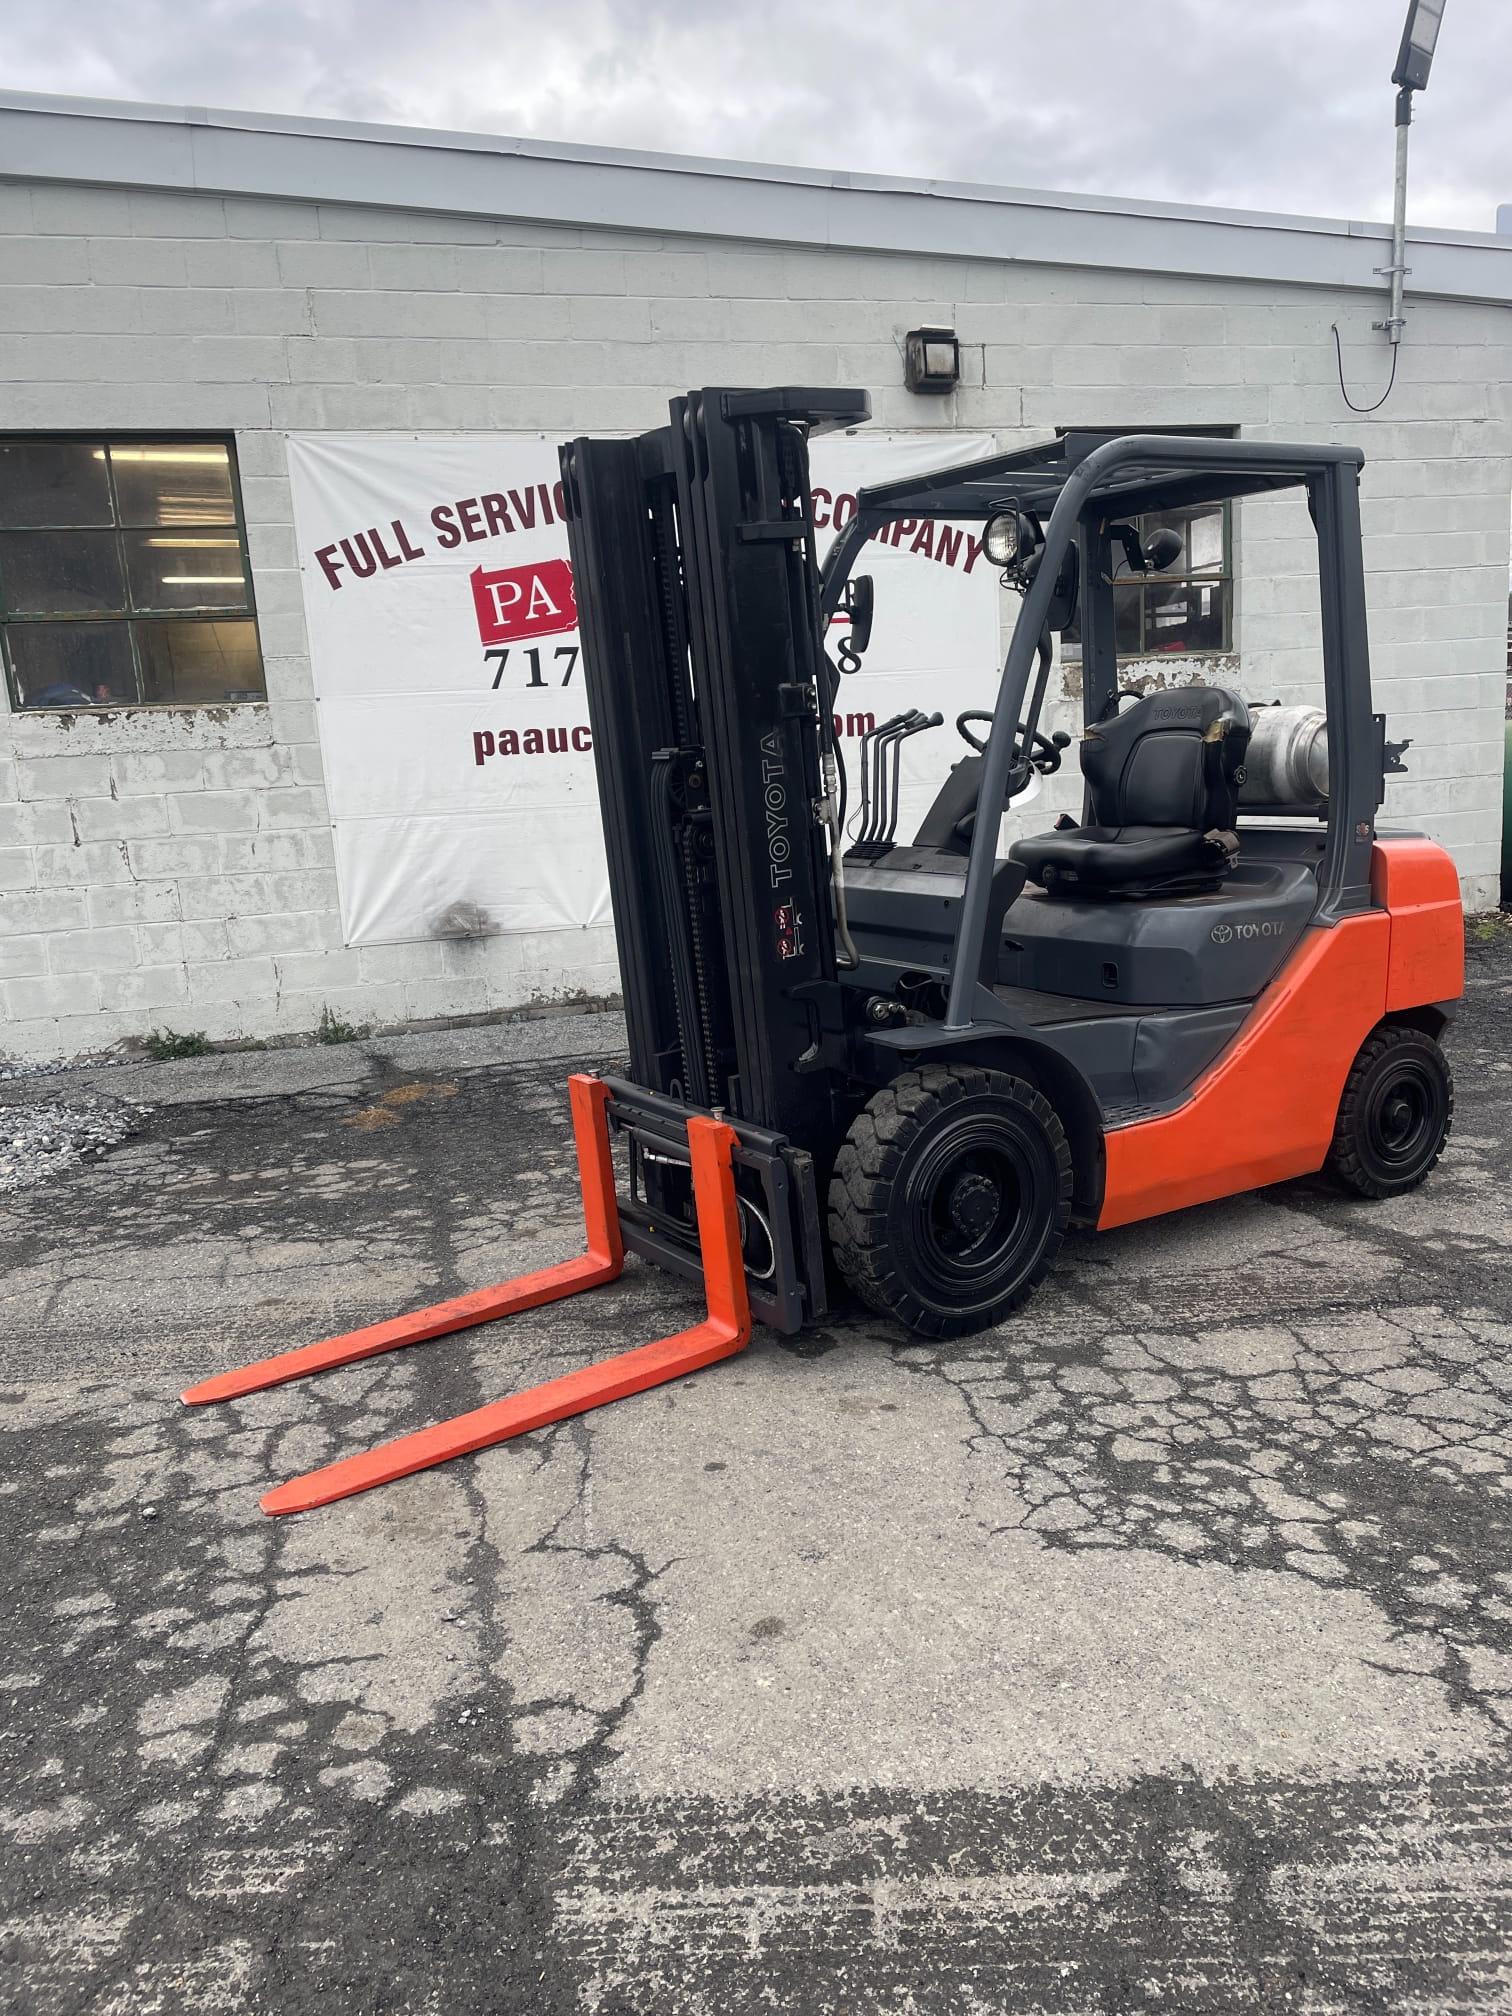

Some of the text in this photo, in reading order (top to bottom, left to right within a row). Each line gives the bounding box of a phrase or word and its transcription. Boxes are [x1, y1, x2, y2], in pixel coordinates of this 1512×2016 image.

[314, 519, 426, 591] FULL
[811, 487, 983, 574] COPANY
[484, 574, 562, 626] PA
[483, 647, 579, 690] 717
[1152, 704, 1204, 720] TOYOTA
[760, 728, 793, 888] TOYOTA
[1234, 921, 1286, 939] TOYOTA
